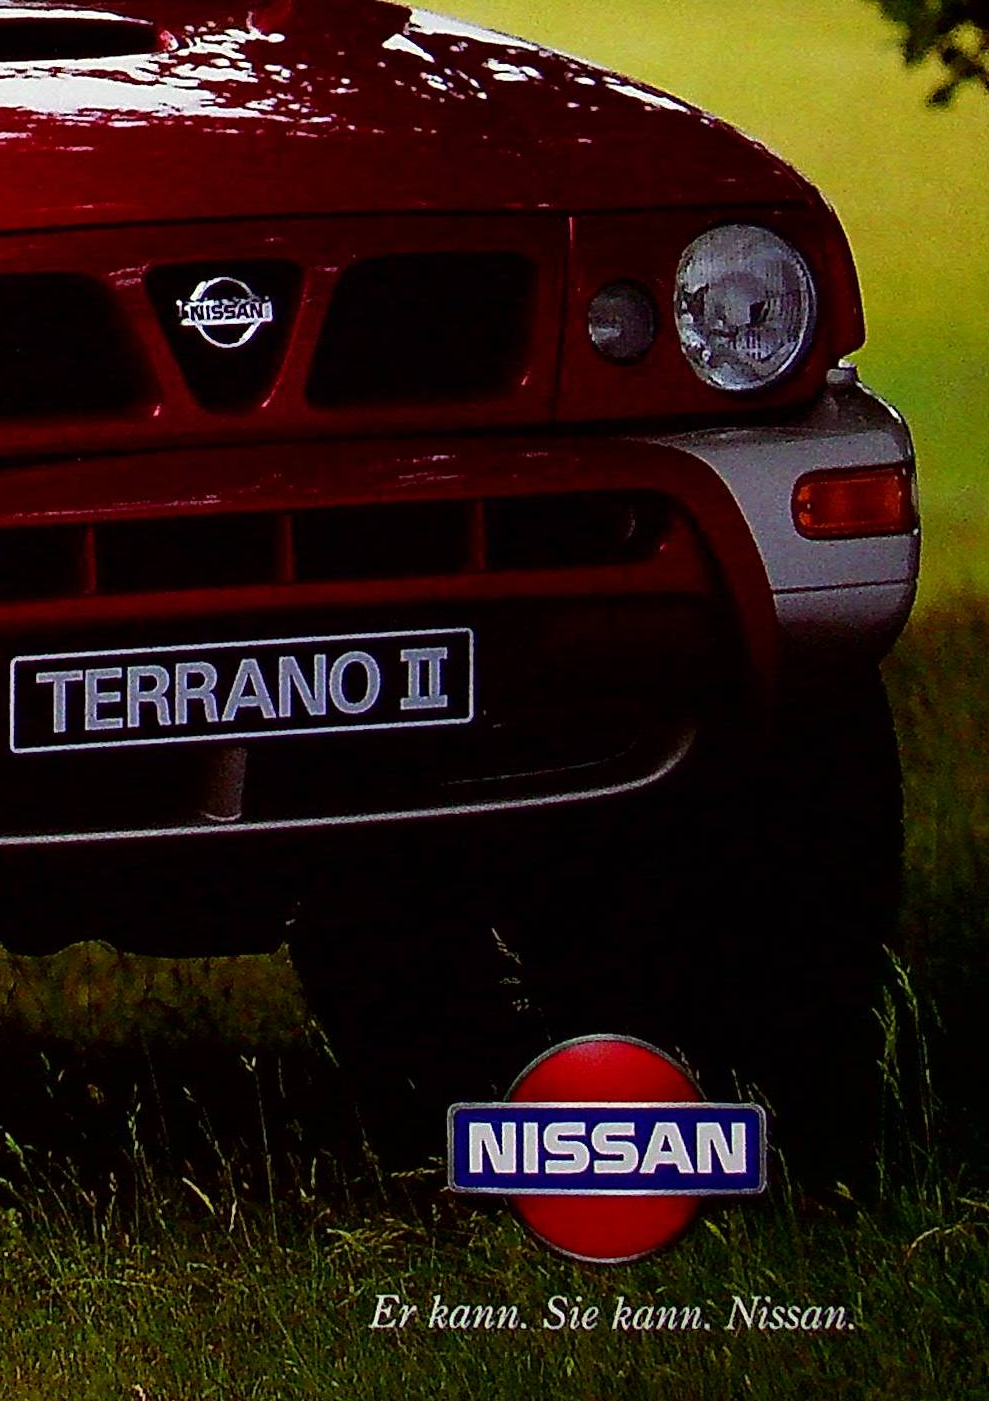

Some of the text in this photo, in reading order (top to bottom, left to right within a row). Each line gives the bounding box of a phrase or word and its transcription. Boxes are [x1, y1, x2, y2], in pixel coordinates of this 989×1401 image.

[189, 301, 263, 321] NISSAN
[35, 646, 449, 734] TERRANO II
